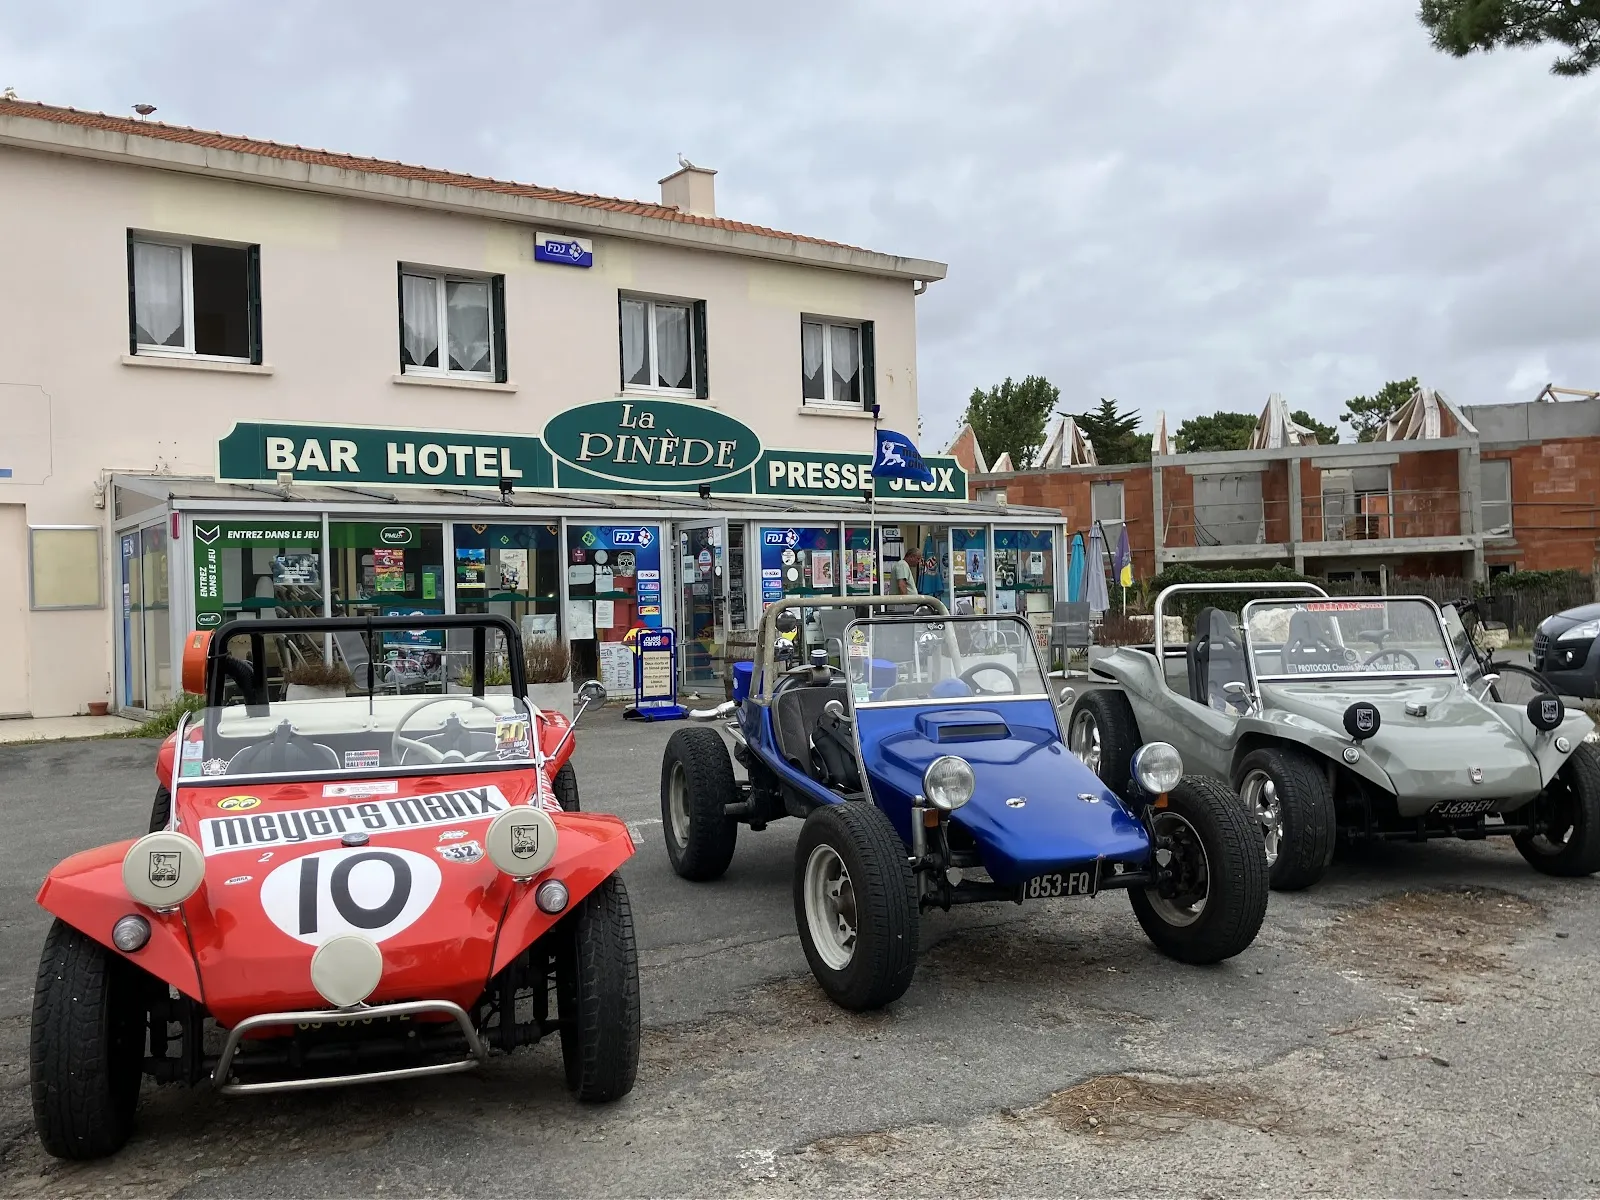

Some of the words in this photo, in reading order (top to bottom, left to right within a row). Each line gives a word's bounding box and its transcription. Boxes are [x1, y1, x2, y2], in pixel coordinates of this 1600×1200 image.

[547, 243, 566, 254] FDJ
[619, 404, 655, 430] La
[266, 437, 360, 473] BAR
[387, 442, 523, 478] HOTEL
[769, 460, 873, 490] PRESSE
[227, 530, 264, 539] ENTREZ
[264, 530, 290, 539] DANS
[292, 531, 302, 539] LE
[303, 531, 320, 539] JEU
[615, 532, 635, 542] FDJ
[766, 533, 783, 543] FDJ
[208, 548, 216, 562] JEU
[209, 563, 217, 573] LE
[199, 566, 208, 597] ENTREZ
[209, 574, 217, 597] DANS
[1298, 664, 1332, 672] PROTOCOX
[497, 722, 524, 742] 50
[210, 804, 387, 846] meyers
[388, 786, 502, 827] manx
[258, 852, 274, 863] 2
[451, 845, 478, 859] 32
[299, 851, 412, 935] 10
[1029, 872, 1090, 898] 853-FQ
